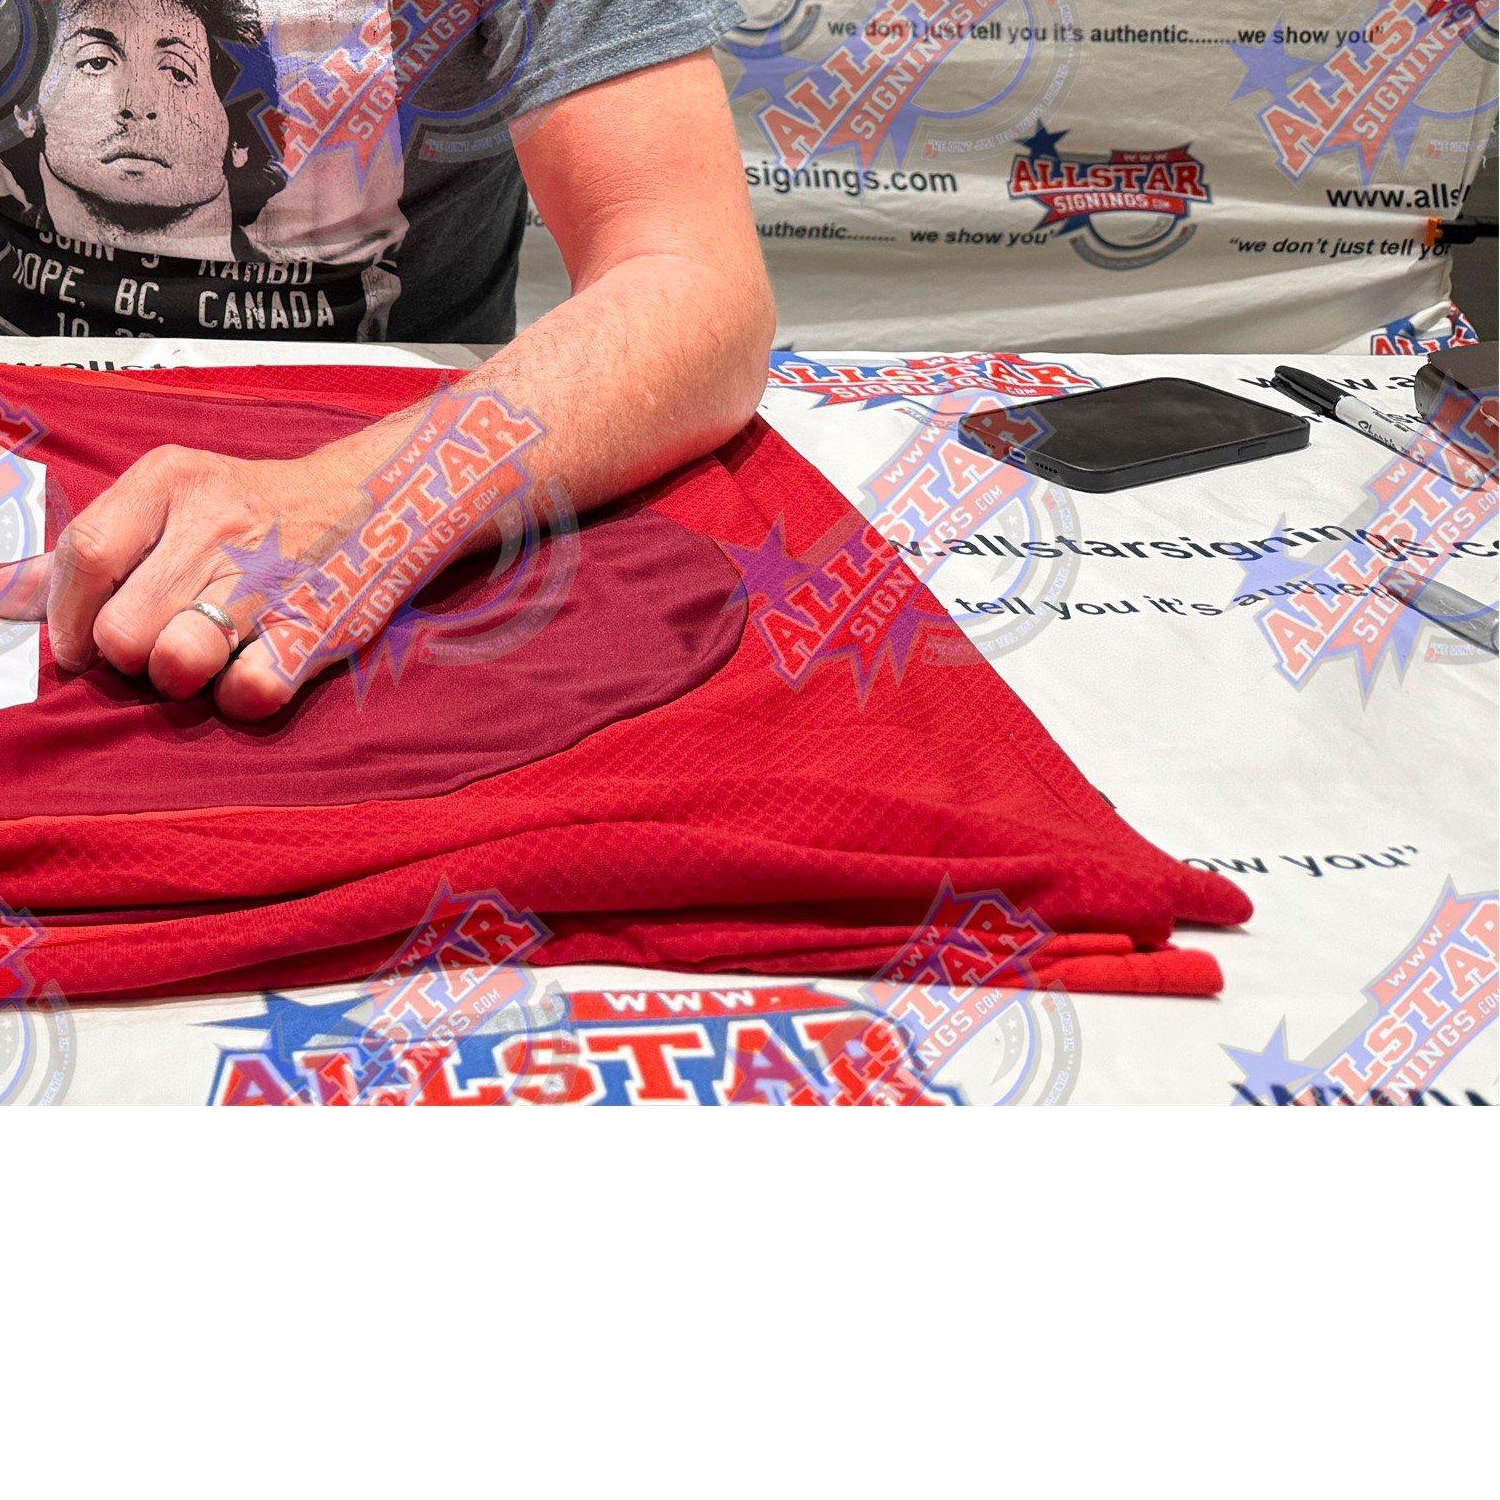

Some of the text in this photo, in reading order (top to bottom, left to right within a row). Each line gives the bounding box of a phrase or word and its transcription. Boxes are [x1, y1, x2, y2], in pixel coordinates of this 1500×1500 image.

[1009, 157, 1211, 202] ALLSTAR
[1052, 191, 1150, 214] SIGNINGS
[198, 290, 335, 331] CANADA
[962, 596, 1036, 617] tell
[1040, 597, 1136, 621] you
